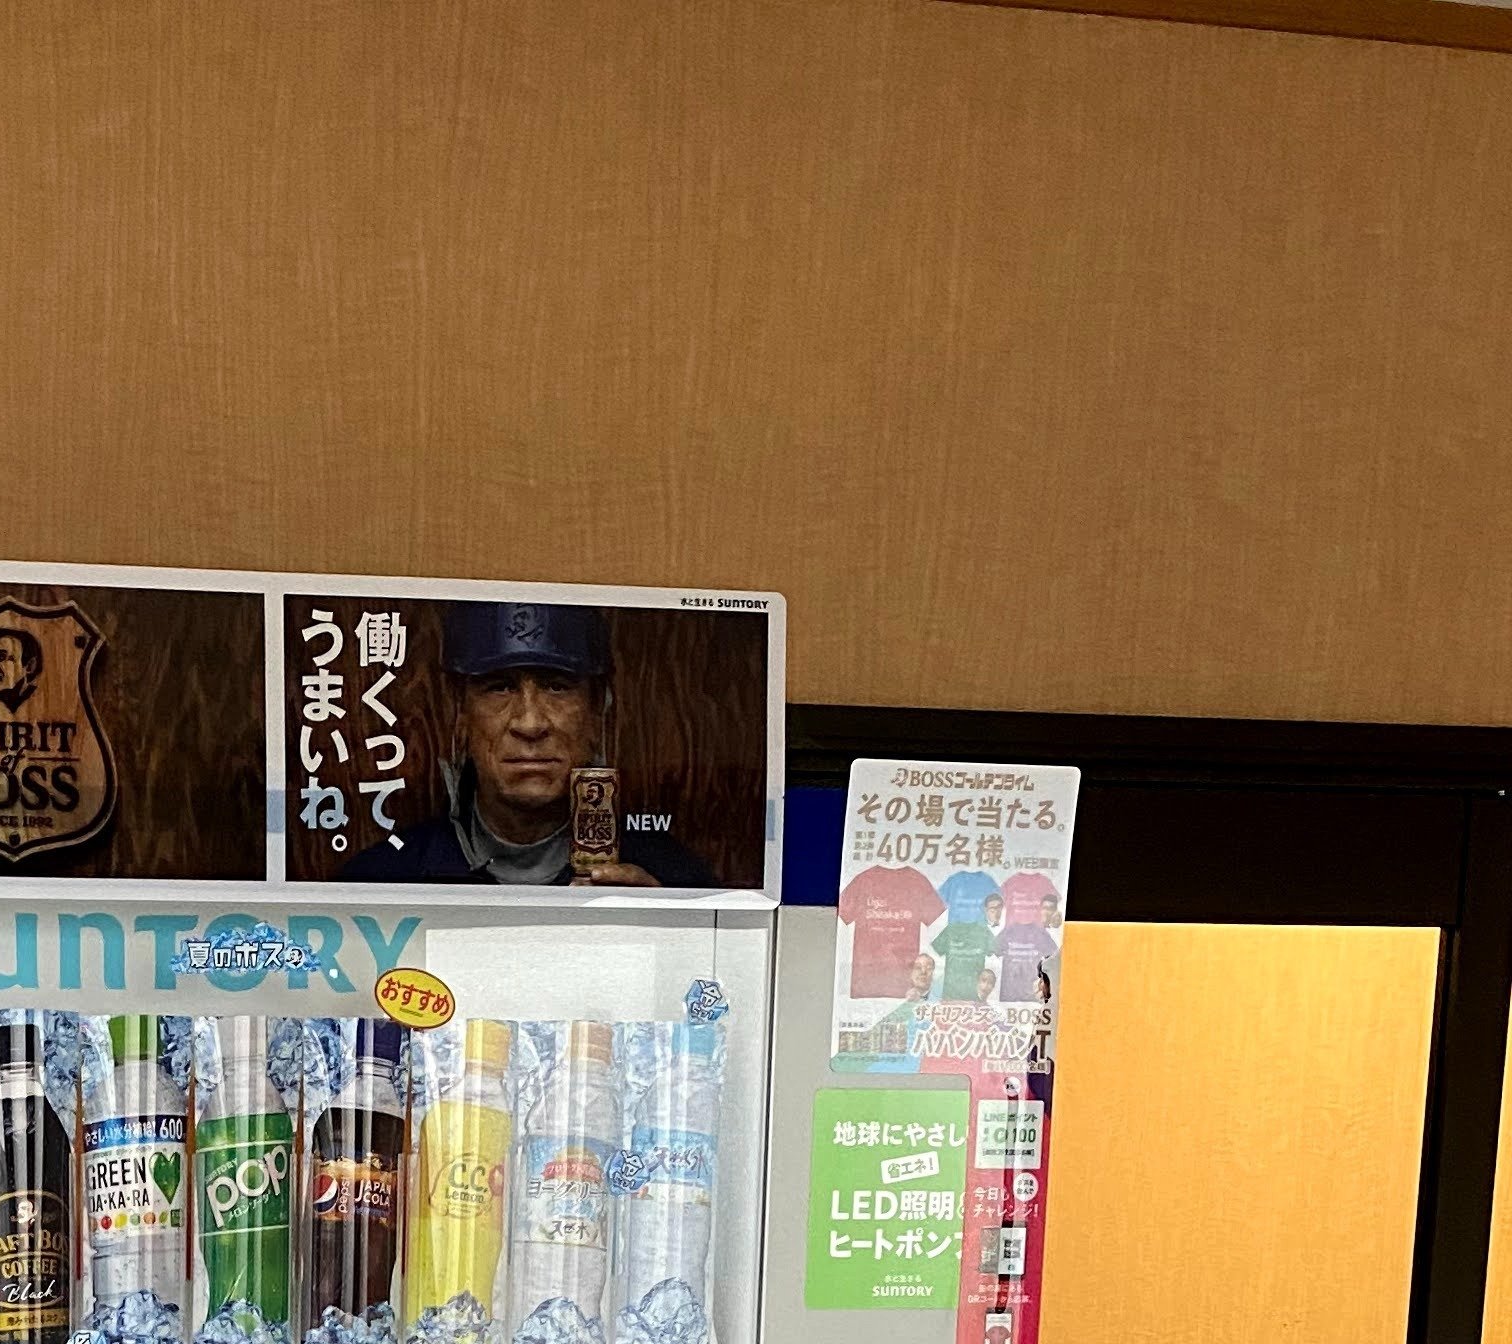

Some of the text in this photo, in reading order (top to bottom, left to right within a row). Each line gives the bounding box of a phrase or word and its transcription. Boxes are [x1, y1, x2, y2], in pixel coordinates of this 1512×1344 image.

[717, 597, 769, 609] SUNTORY
[300, 609, 348, 852] うまいね。
[354, 611, 406, 851] 働くって、
[626, 813, 672, 832] NEW
[857, 793, 1065, 832] その場で当たる。
[877, 832, 1010, 870] 40万名様。
[188, 940, 286, 969] 夏のボス
[380, 978, 450, 1017] おすすめ
[1007, 1008, 1052, 1025] BOSS
[159, 1118, 182, 1139] 600
[88, 1157, 146, 1190] GREEN
[206, 1144, 289, 1229] pop
[448, 1162, 488, 1193] C.C.
[363, 1193, 391, 1205] COLA
[445, 1190, 484, 1203] Lemon
[0, 1257, 57, 1279] COFFEE
[2, 1279, 56, 1302] Black
[872, 1286, 933, 1297] SUNTORY
